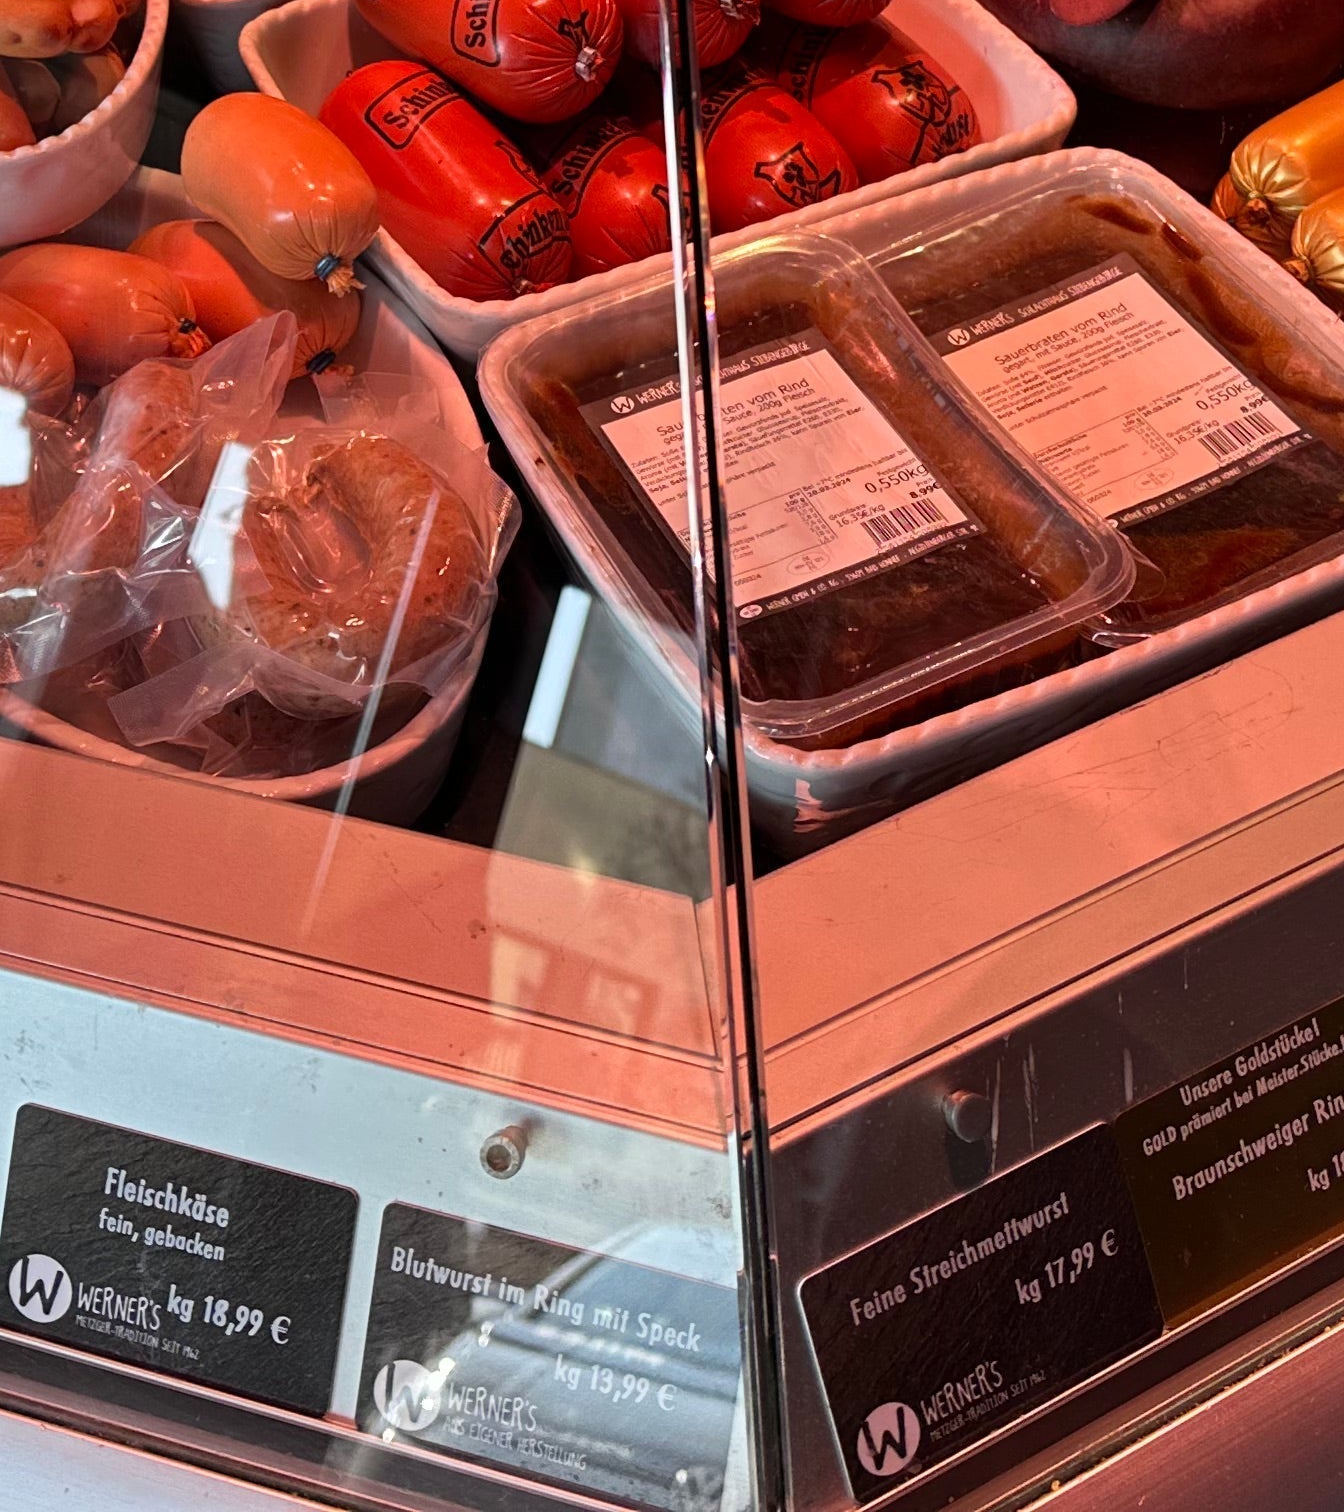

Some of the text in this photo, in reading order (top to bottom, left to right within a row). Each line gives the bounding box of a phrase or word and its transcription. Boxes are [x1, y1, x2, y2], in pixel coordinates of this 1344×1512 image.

[993, 302, 1128, 366] Sauerbraten vom Rind
[1080, 325, 1105, 339] 200g
[1102, 311, 1135, 328] Fleisch
[746, 390, 777, 406] vom
[777, 377, 810, 395] Rind
[756, 398, 783, 413] 200g
[782, 386, 815, 402] Fleisch
[863, 461, 931, 494] 0,550kg
[1179, 1016, 1320, 1106] Unsere Goldstücke!
[1141, 1125, 1177, 1156] GOLD
[1179, 1096, 1233, 1141] prämiert
[1232, 1084, 1254, 1109] bei
[1171, 1112, 1309, 1201] Braunschweiger
[1306, 1167, 1330, 1192] kg
[103, 1165, 230, 1228] Fleischkäse
[97, 1206, 225, 1261] fein, gebacken
[848, 1190, 1069, 1326] Feine Streichmettwurst
[1013, 1227, 1119, 1305] kg 17,99 €
[76, 1281, 162, 1331] WERNER'S
[165, 1283, 291, 1345] kg 18,99 €
[389, 1244, 702, 1357] Blutwurst im Ring mit Speck
[446, 1379, 539, 1433] WERNER'S
[553, 1353, 679, 1413] kg 13,99 €
[919, 1359, 1003, 1426] WERNER'S
